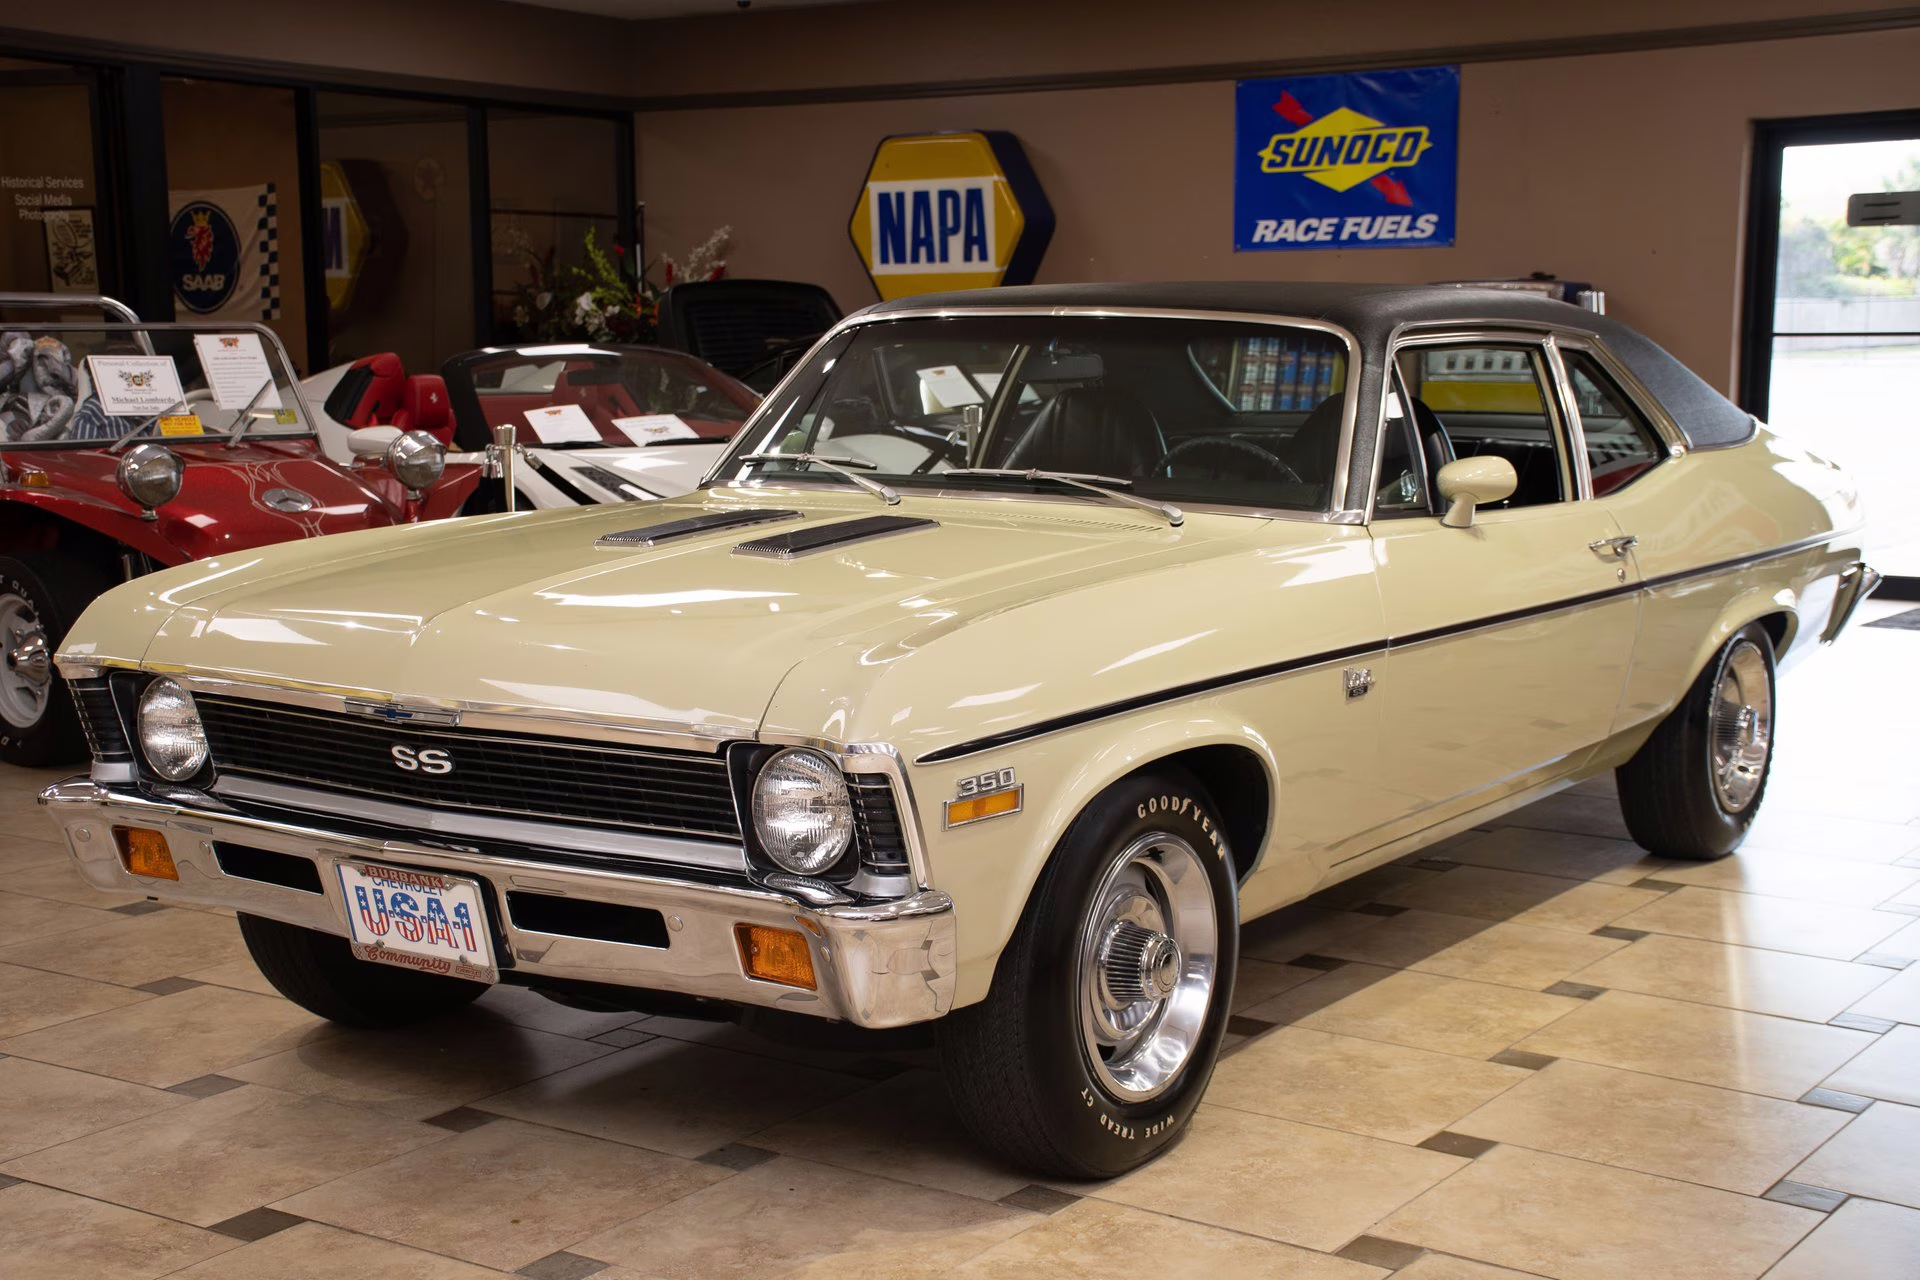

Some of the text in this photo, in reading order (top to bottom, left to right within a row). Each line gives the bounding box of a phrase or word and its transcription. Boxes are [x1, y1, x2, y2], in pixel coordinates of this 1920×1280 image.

[1266, 131, 1423, 169] SUNOCO
[1, 176, 85, 189] Historical Services
[15, 193, 72, 207] Social Media
[878, 188, 989, 265] NAPA
[1252, 213, 1439, 243] RACE FUELS
[183, 274, 225, 291] SAAB
[391, 744, 453, 775] SS
[959, 767, 1015, 797] 350
[1138, 795, 1225, 861] GOODYEAR
[368, 866, 443, 889] BURBANK
[364, 945, 451, 974] Community
[1100, 1112, 1135, 1140] TREAD
[1145, 1114, 1174, 1138] WIDE
